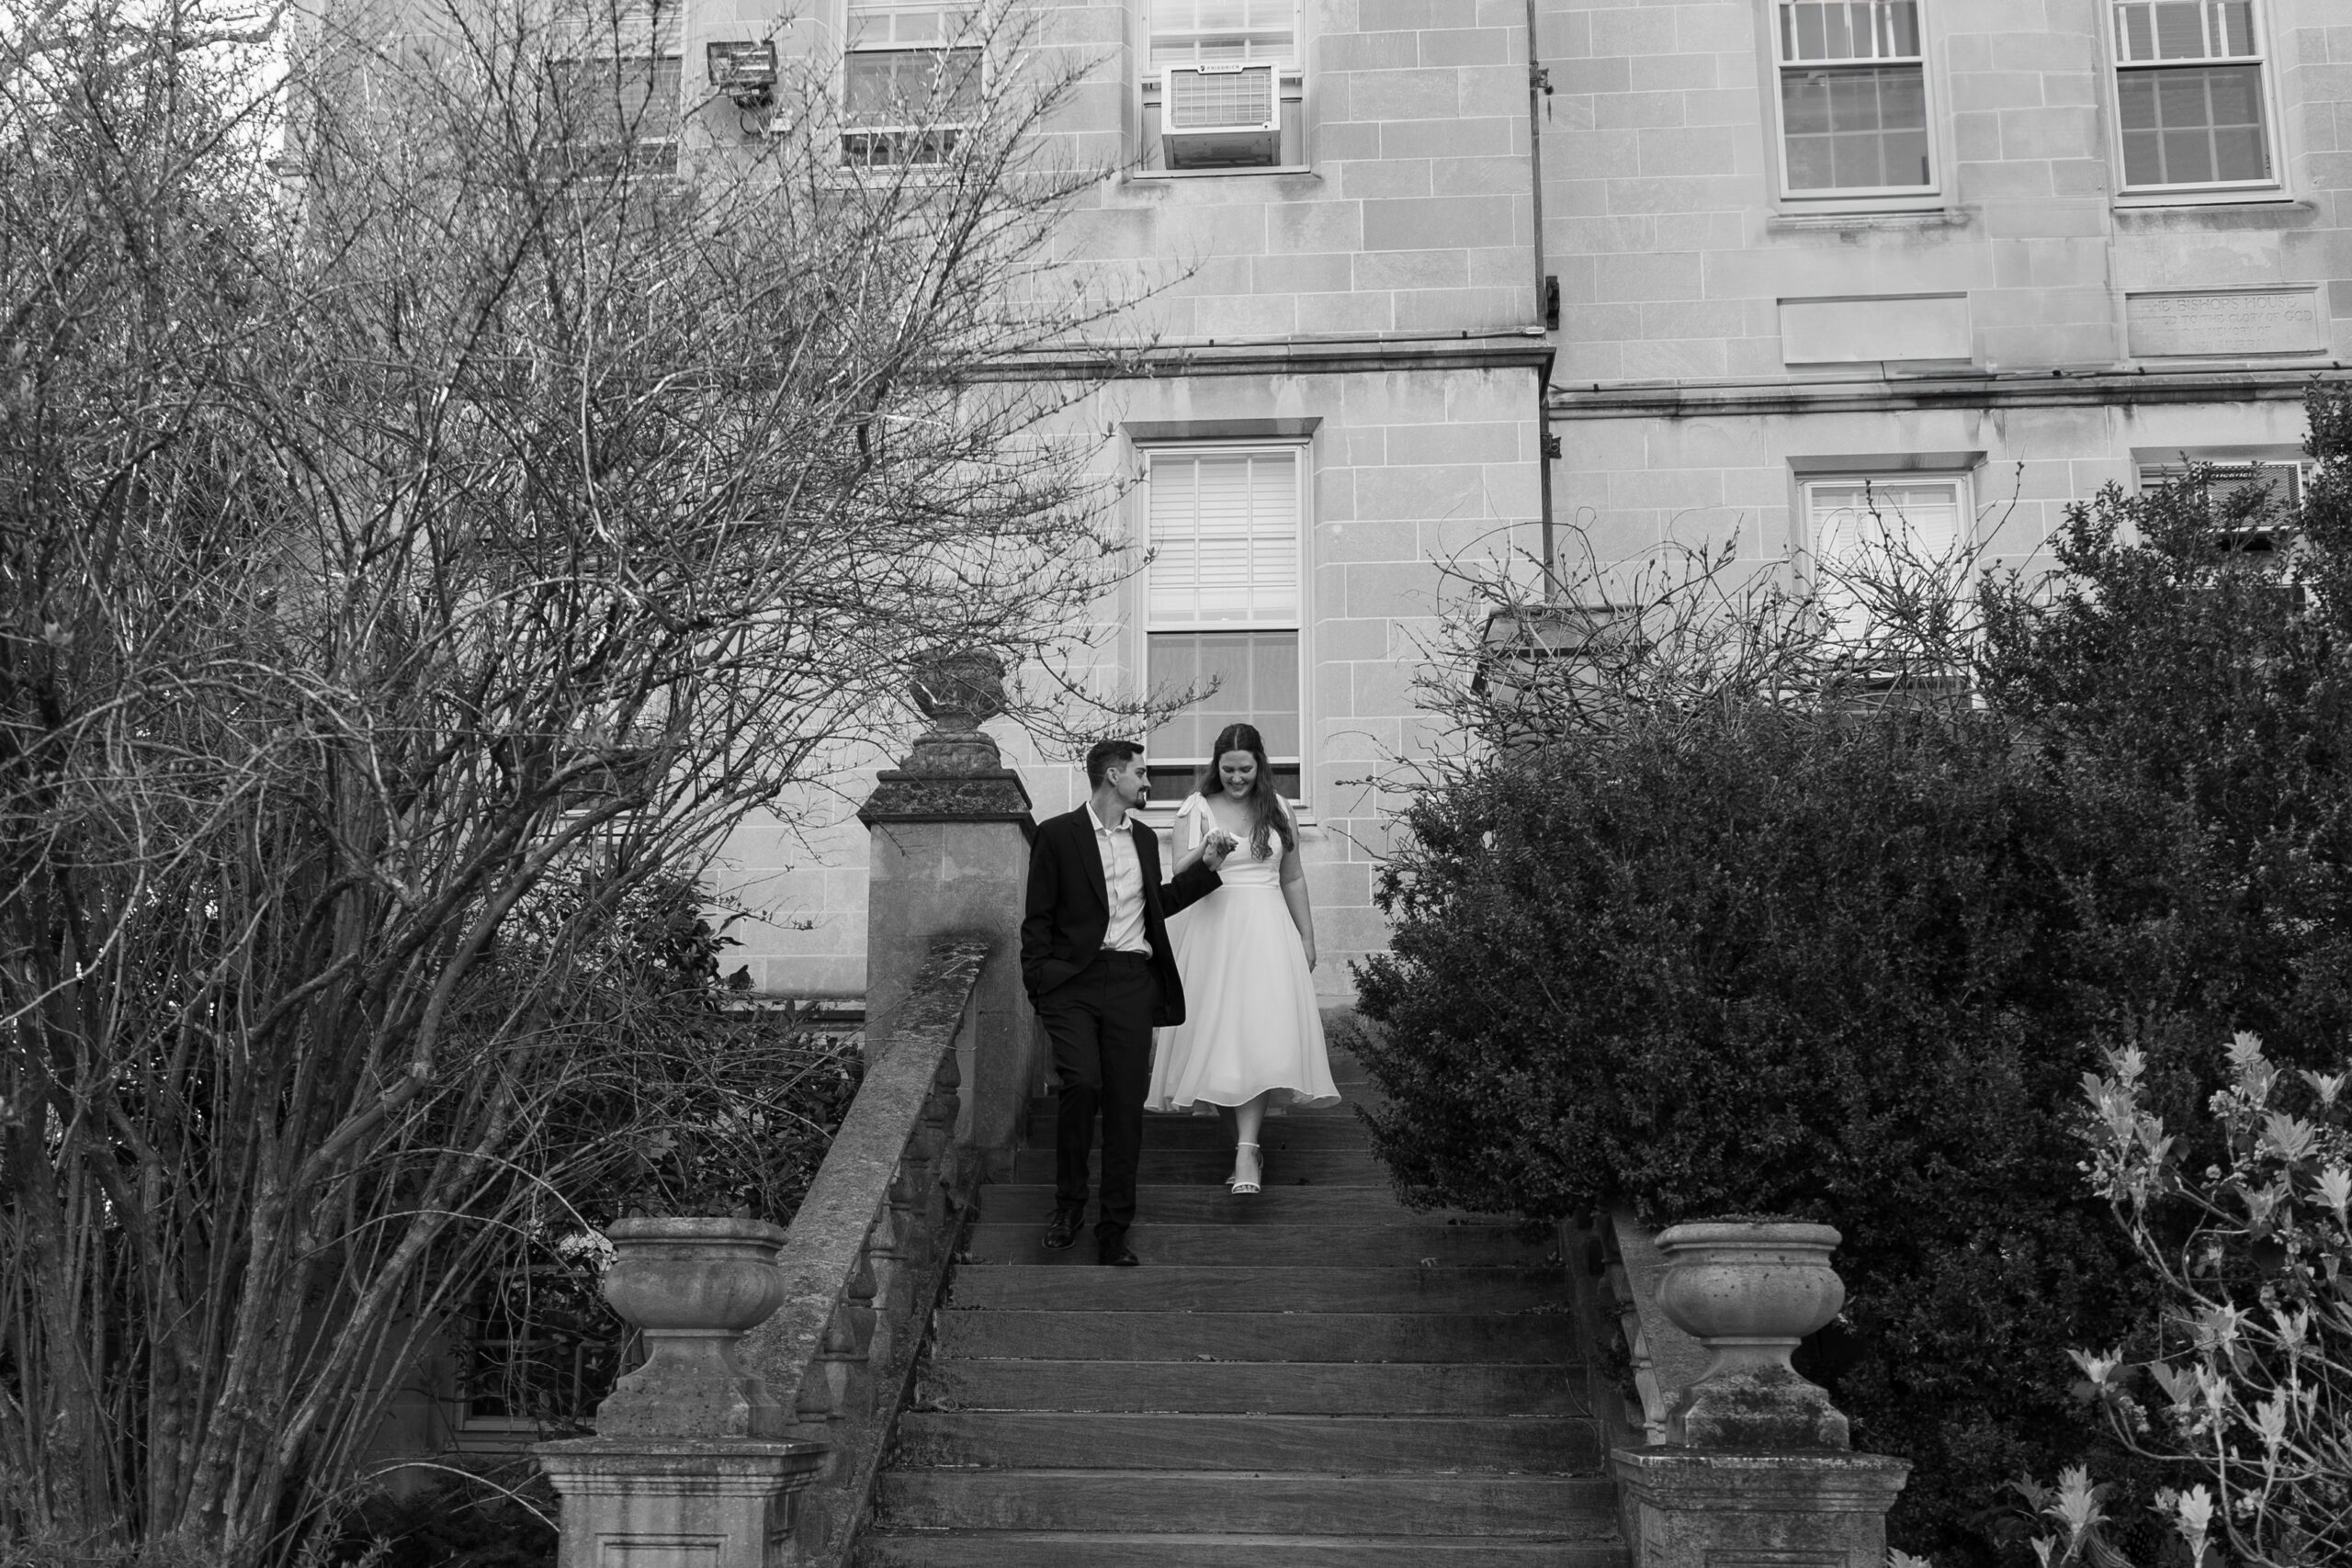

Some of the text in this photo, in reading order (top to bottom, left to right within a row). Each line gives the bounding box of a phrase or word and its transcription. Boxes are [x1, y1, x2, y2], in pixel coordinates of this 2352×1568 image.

[2177, 298, 2240, 312] BISHOPS
[2244, 295, 2298, 310] HOUSE
[2181, 314, 2198, 325] TO
[2200, 313, 2224, 324] THE
[2228, 313, 2262, 323] GLORY
[2266, 312, 2279, 322] OF
[2284, 310, 2313, 322] GOD
